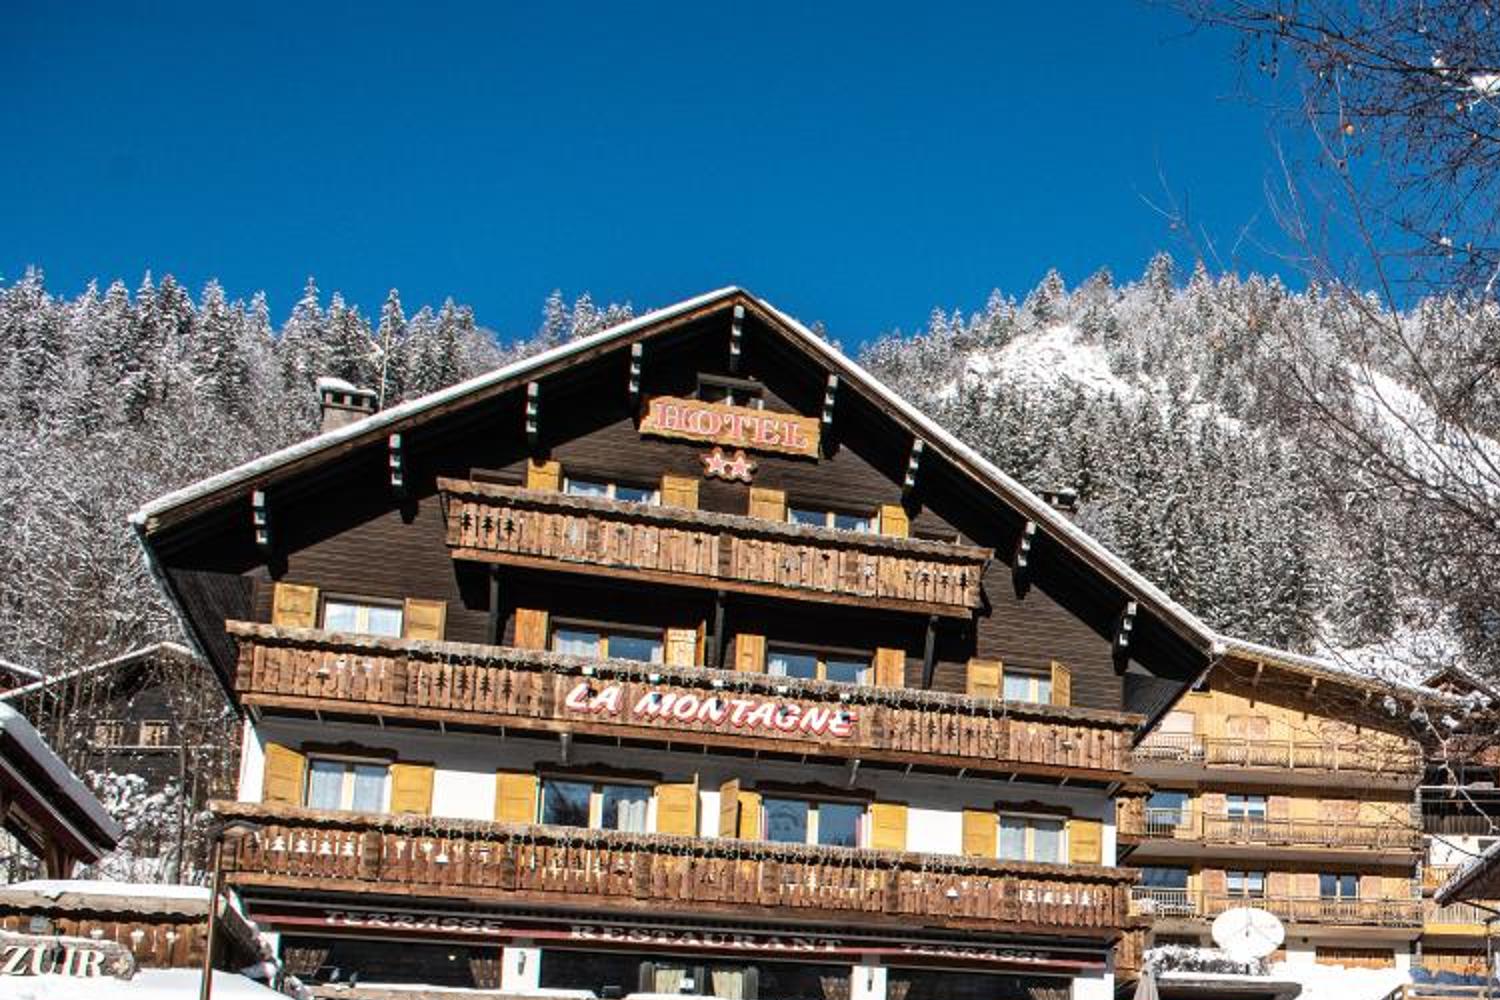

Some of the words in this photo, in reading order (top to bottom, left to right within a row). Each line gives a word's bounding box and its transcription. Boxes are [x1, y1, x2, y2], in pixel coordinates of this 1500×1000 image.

[655, 403, 809, 449] HOTEL
[565, 683, 620, 716] LA
[633, 690, 858, 737] MONTAGNE
[323, 909, 504, 933] TERRASSE
[569, 925, 842, 951] RESTAURANT
